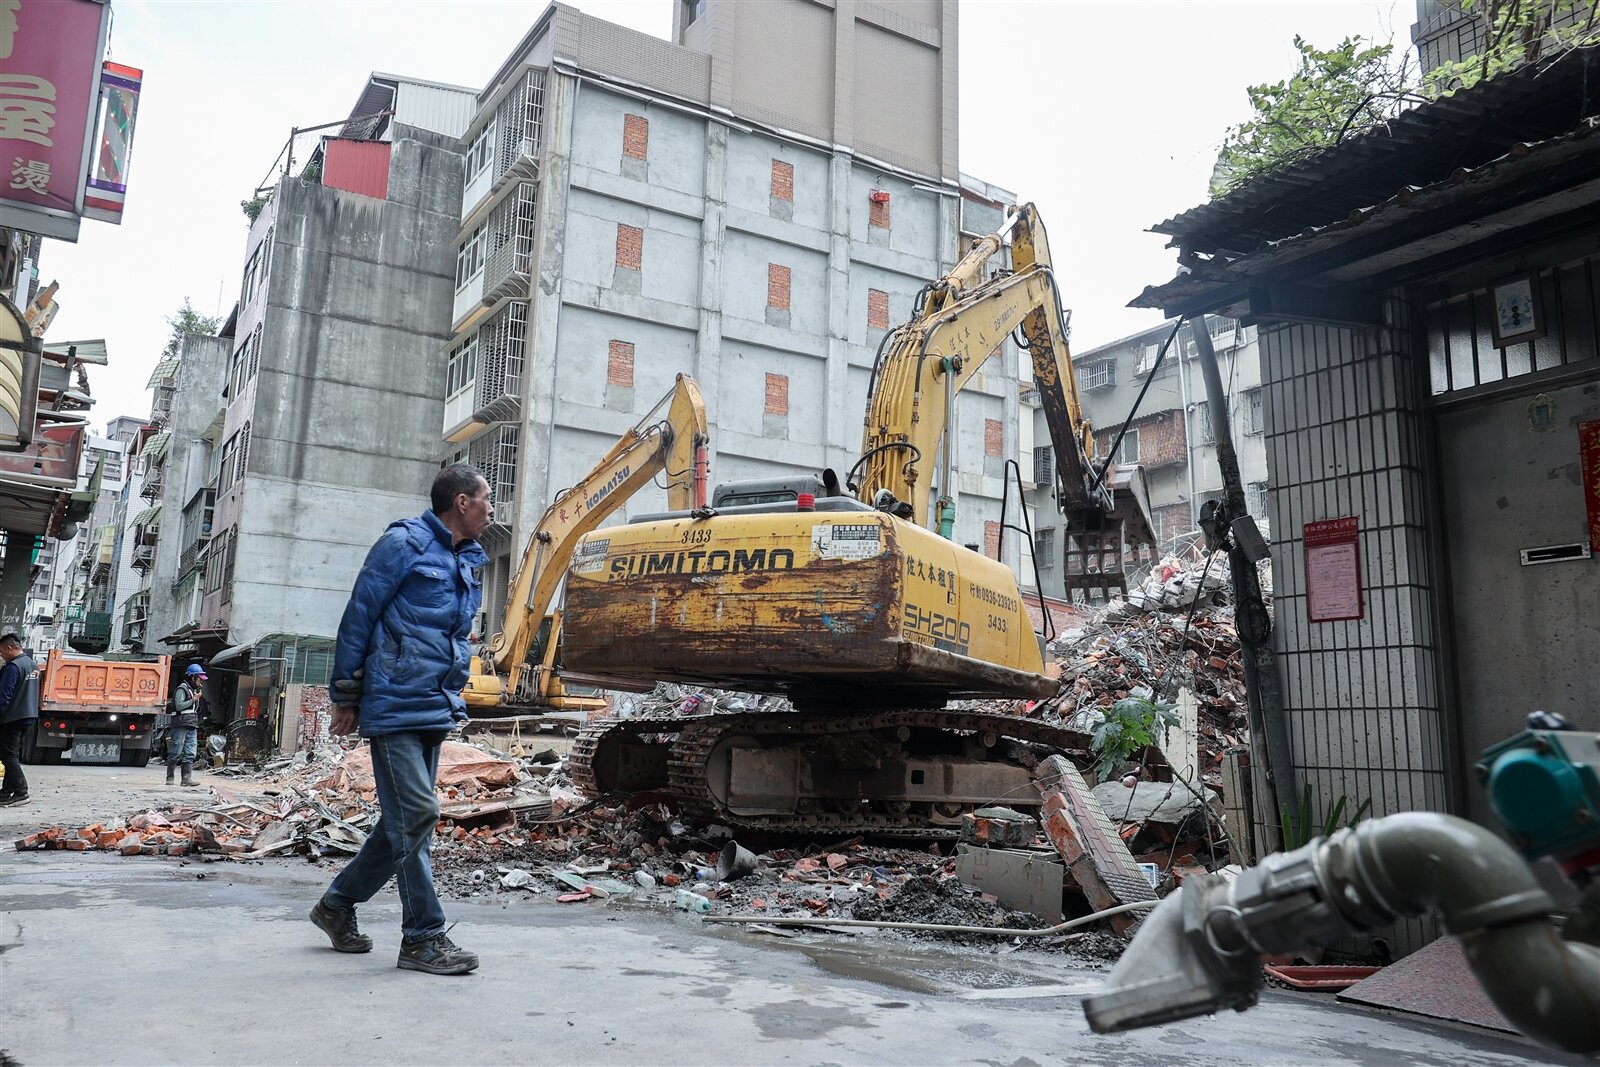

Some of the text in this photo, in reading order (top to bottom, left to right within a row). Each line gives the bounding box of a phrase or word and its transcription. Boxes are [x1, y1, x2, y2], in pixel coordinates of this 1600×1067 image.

[9, 156, 52, 195] 燙
[586, 464, 630, 511] KOMATSU
[681, 529, 712, 544] 3433
[608, 548, 795, 581] SUMITOMO
[67, 606, 80, 618] 新
[903, 602, 971, 646] SH200
[987, 613, 1007, 633] 3433
[902, 630, 936, 648] SUMITOMO
